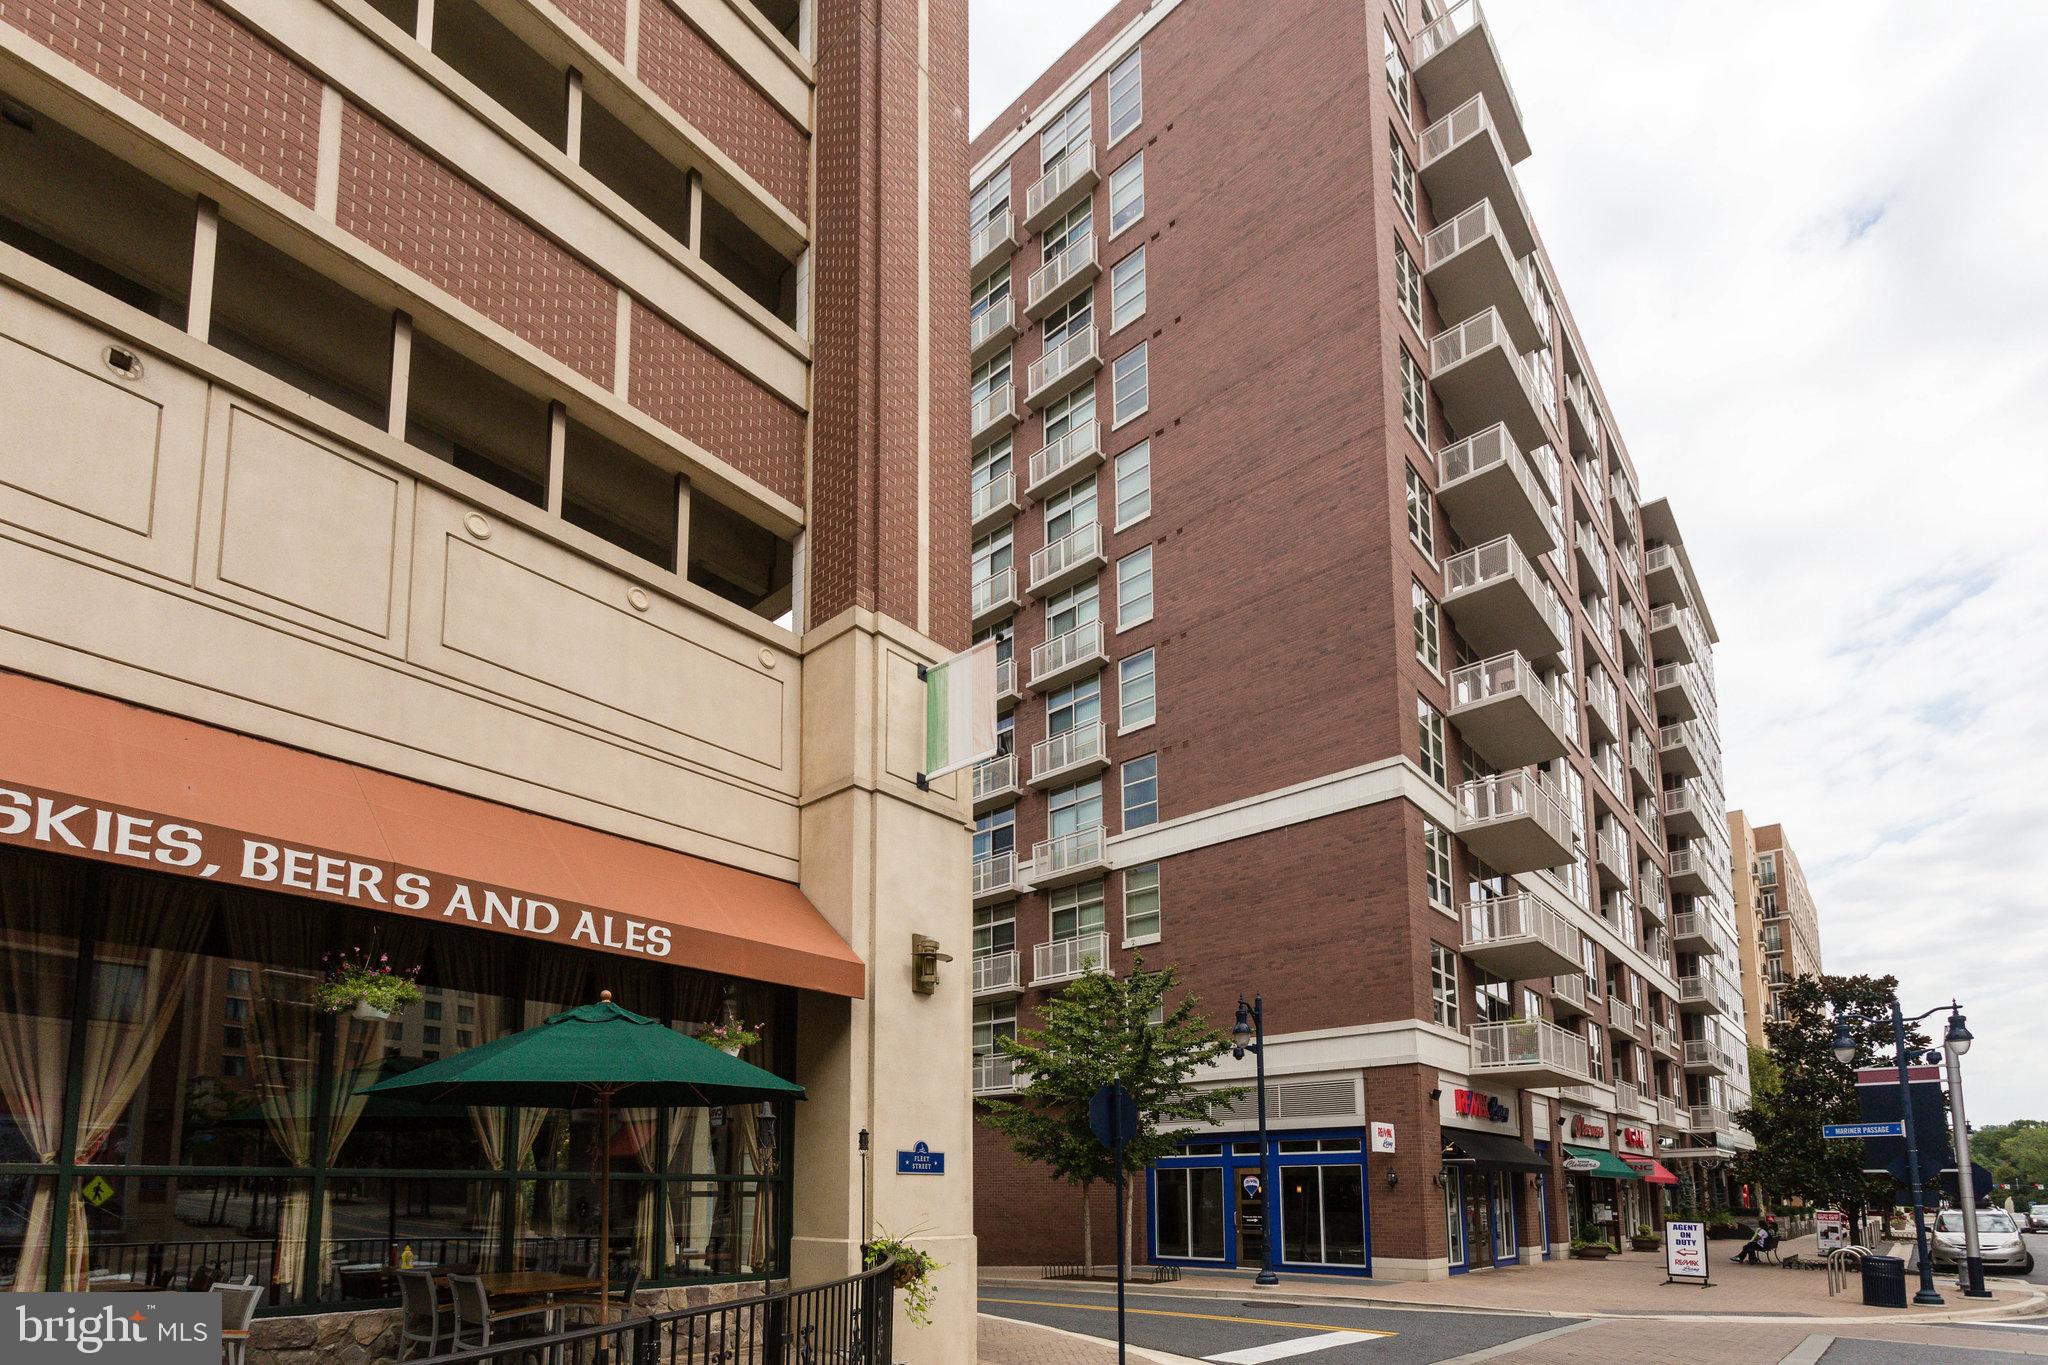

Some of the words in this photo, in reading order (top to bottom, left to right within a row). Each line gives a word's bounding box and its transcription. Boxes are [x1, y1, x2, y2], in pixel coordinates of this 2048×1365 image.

[240, 839, 431, 910] BEERS
[443, 883, 560, 934] AND
[570, 910, 672, 957] ALES
[1835, 1127, 1862, 1135] MARINER
[1862, 1125, 1890, 1134] PASSAGE
[1674, 1259, 1699, 1267] RE/MAX
